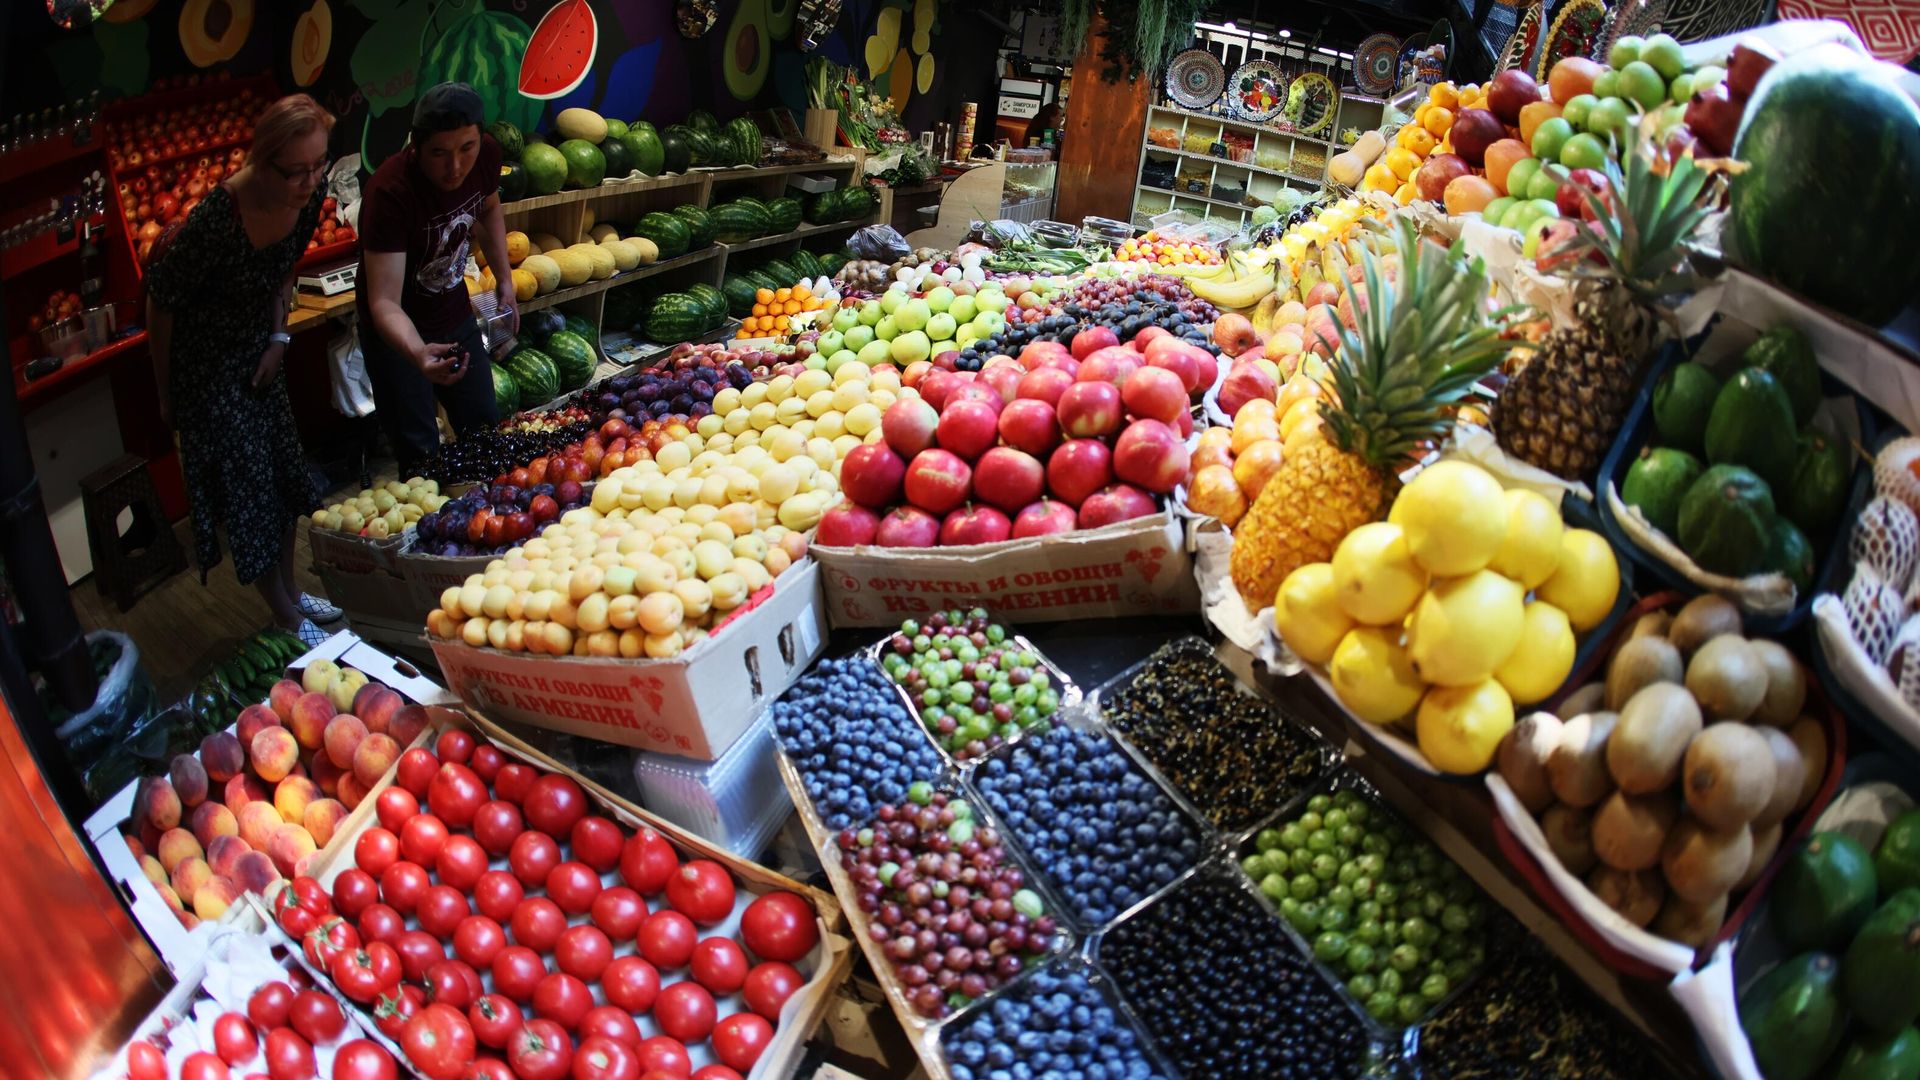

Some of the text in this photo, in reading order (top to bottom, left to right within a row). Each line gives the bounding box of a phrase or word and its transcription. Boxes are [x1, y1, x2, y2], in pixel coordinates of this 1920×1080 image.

[1012, 101, 1037, 109] ЗАМОРСКАЯ
[868, 562, 1123, 594] ФРУКТЫ И ОВОЩИ
[882, 595, 930, 612] ИЗ
[462, 666, 634, 703] ФРУКТЫ И ОВОЩИ
[514, 695, 642, 730] АРМЕНИИ
